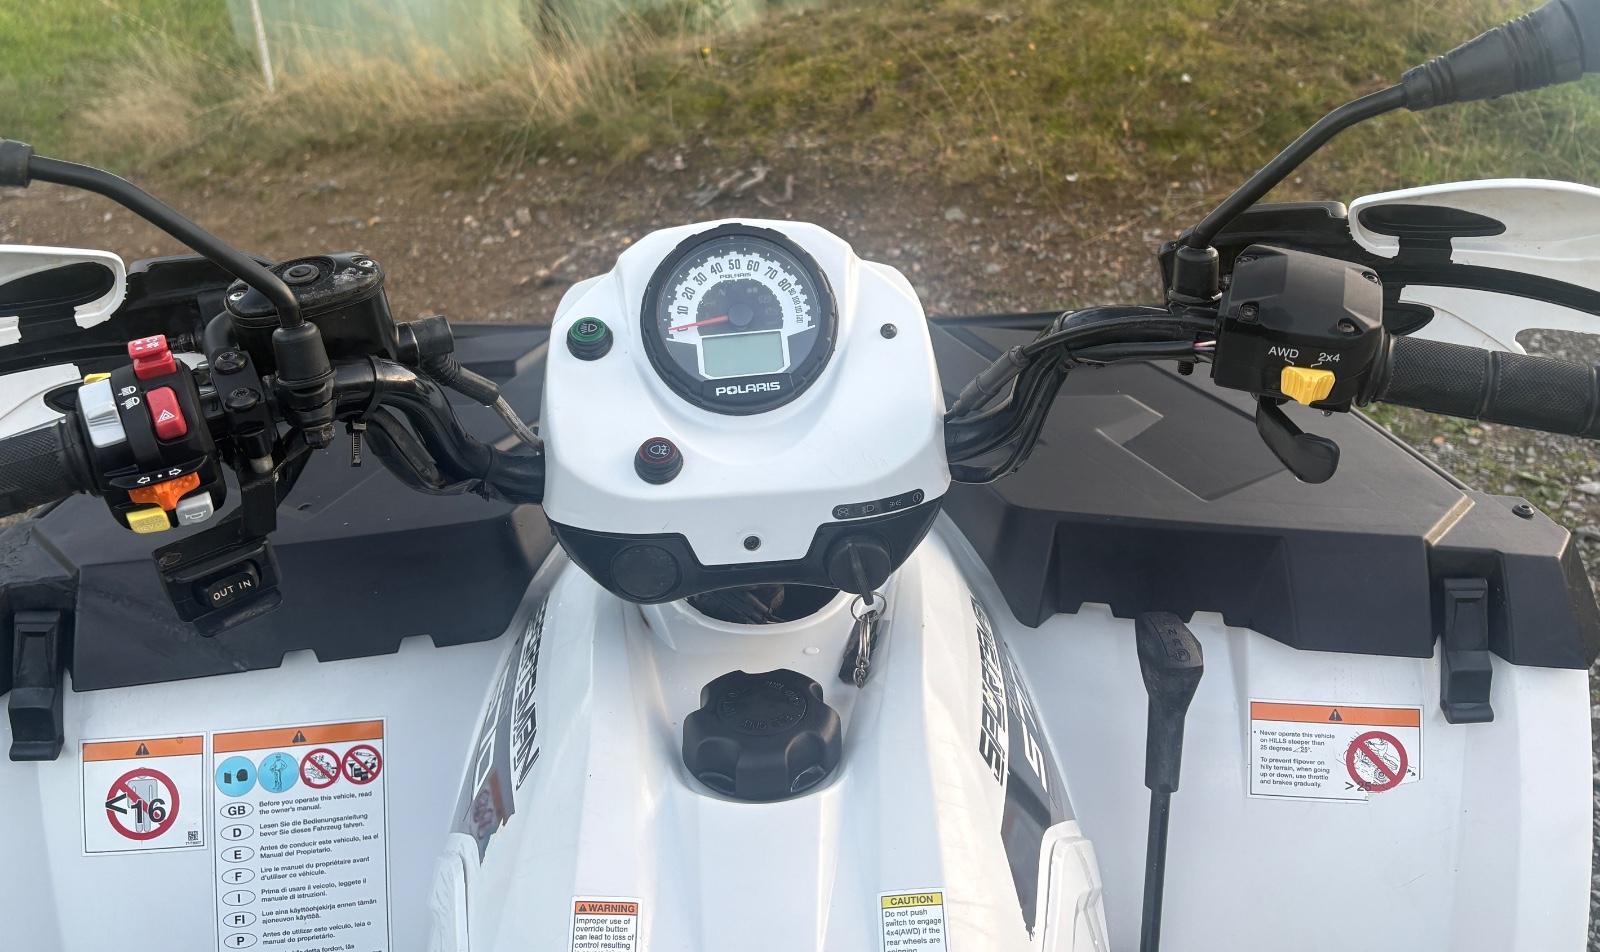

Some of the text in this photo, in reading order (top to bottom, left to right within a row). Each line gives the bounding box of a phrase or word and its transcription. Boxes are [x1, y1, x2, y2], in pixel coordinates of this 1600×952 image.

[710, 263, 723, 274] 40
[729, 259, 740, 270] 50
[747, 260, 760, 272] 60
[766, 267, 777, 279] 70
[693, 272, 707, 287] 30
[778, 278, 791, 292] 80
[682, 287, 696, 300] 20
[677, 306, 688, 315] 10
[1268, 346, 1299, 358] AWD
[1318, 353, 1340, 362] 2x4
[716, 382, 780, 396] POLARIS
[213, 580, 251, 601] OUT IN
[295, 797, 318, 805] operate
[228, 806, 245, 816] GB
[313, 823, 341, 832] Fahrzeug
[233, 828, 241, 837] D
[234, 850, 242, 859] E
[235, 872, 242, 881] F
[238, 894, 240, 902] I
[891, 896, 933, 905] CAUTION
[589, 904, 634, 912] WARNING
[910, 909, 927, 917] push
[235, 915, 245, 924] FI
[577, 917, 608, 925] Improper
[886, 919, 906, 927] switch
[237, 937, 244, 945] P
[601, 942, 630, 950] resulting
